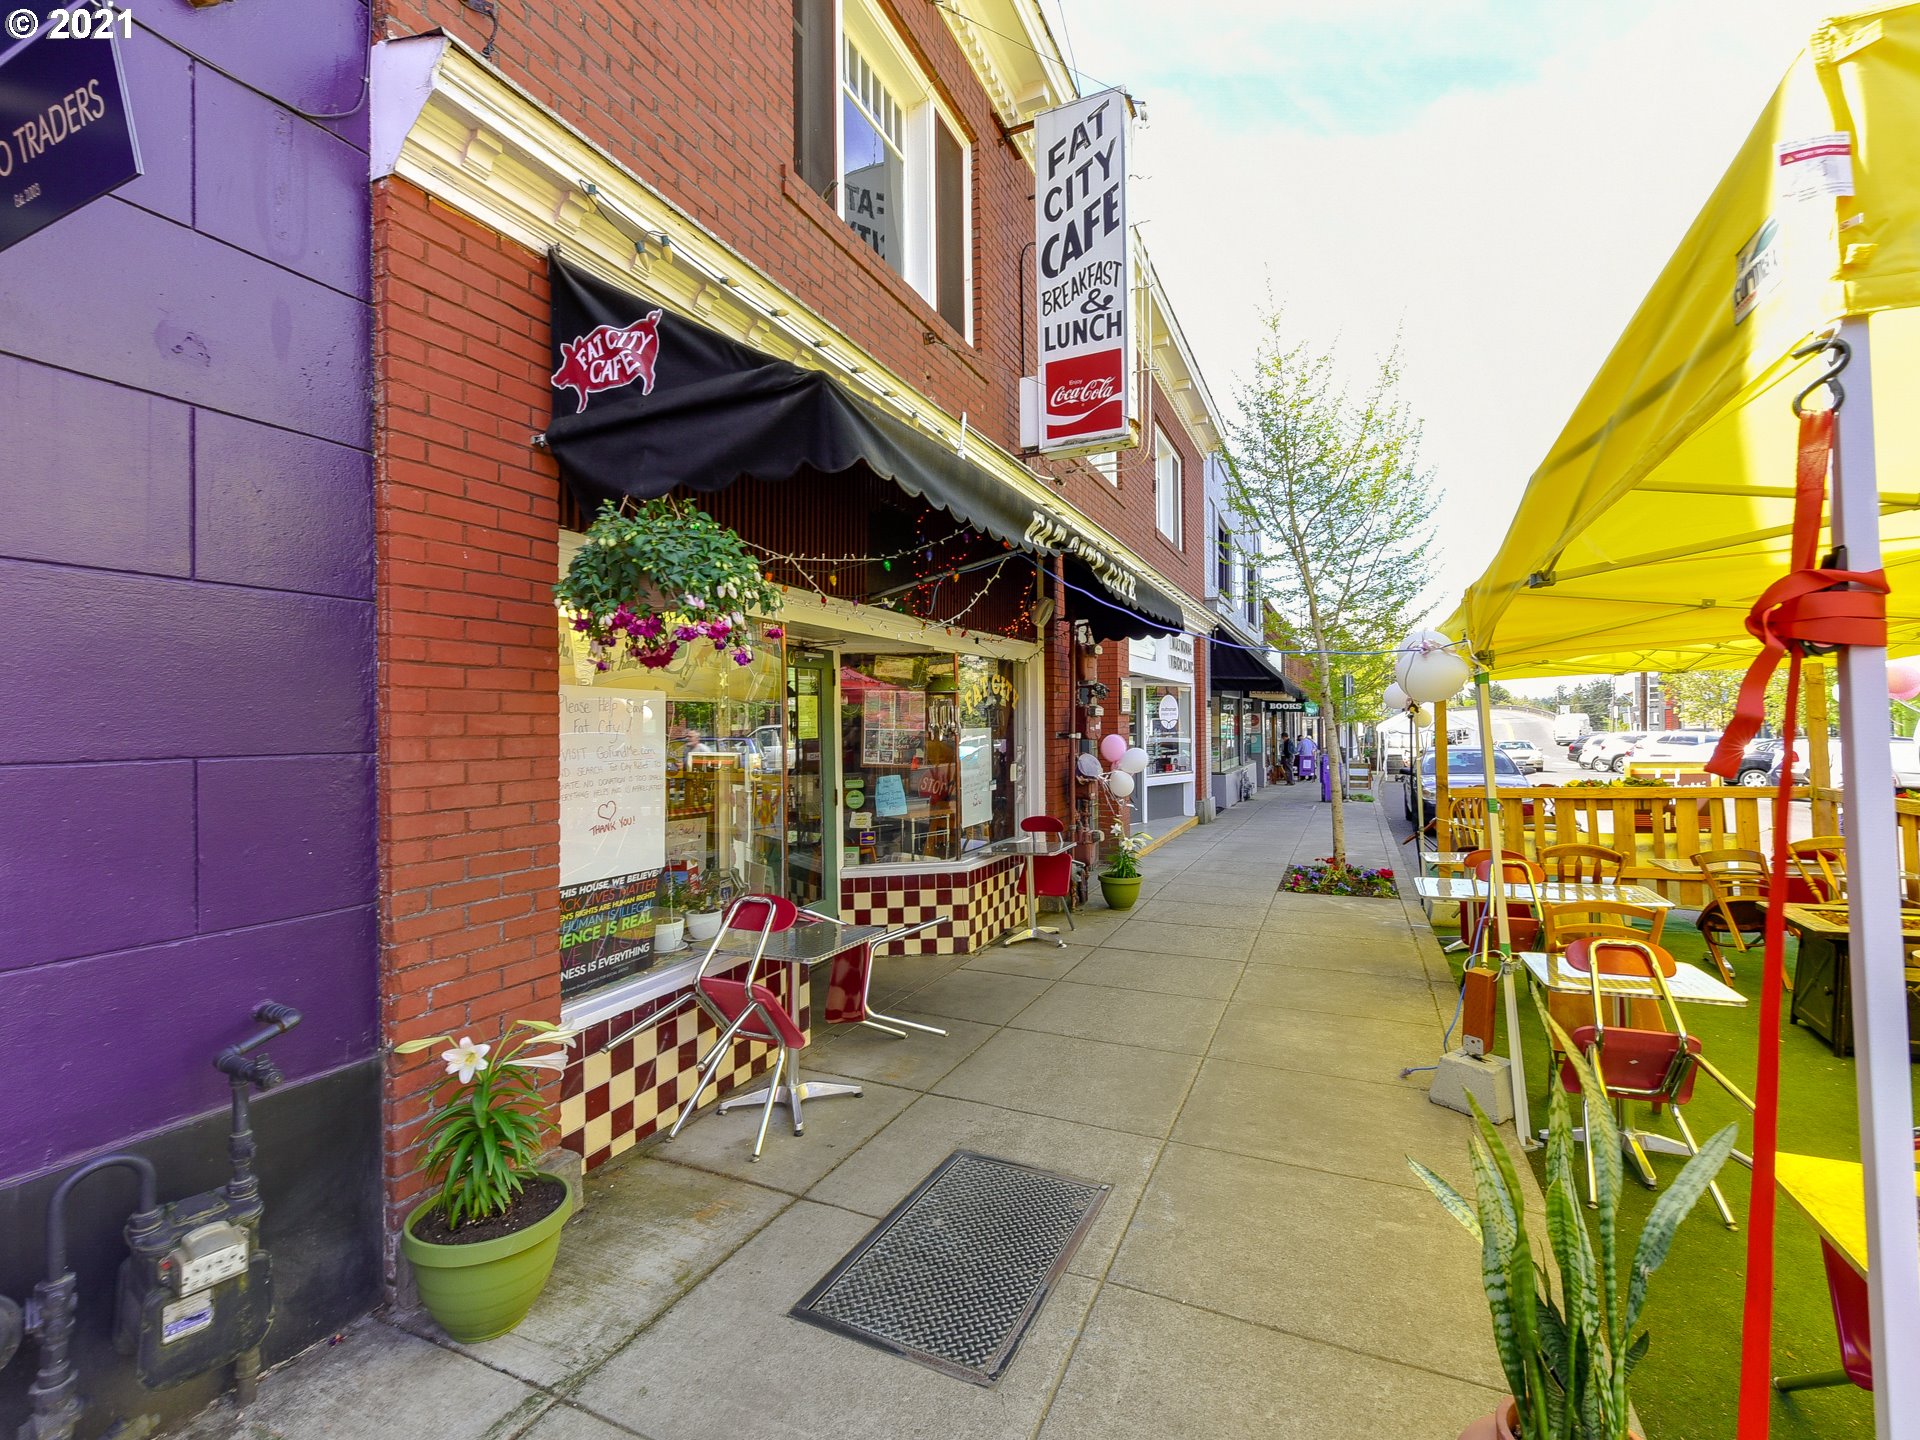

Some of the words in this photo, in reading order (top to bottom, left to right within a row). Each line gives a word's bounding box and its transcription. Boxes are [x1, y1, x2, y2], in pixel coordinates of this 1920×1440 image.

[13, 78, 105, 164] TRADERS
[1048, 99, 1110, 182] FAT
[1044, 136, 1117, 223] CITY
[1041, 182, 1120, 279] CAFE
[1042, 260, 1123, 317] BREAKFAST
[1080, 288, 1114, 314] &
[1044, 310, 1122, 352] LUNCH
[576, 334, 604, 370] FAT
[605, 330, 653, 354] CITY
[590, 350, 640, 383] CAFE
[1050, 376, 1116, 407] Coca-Cola
[1024, 510, 1067, 549] FAT
[1102, 562, 1137, 601] CAFE
[559, 694, 592, 714] Please
[598, 696, 617, 717] Help
[626, 698, 648, 714] Sav
[964, 676, 991, 716] FAT
[991, 673, 1020, 710] CITY
[1269, 702, 1303, 711] BOOKS
[573, 718, 590, 734] Fat
[561, 747, 587, 762] VISIT
[589, 821, 617, 836] THANK
[619, 815, 636, 828] YOU!
[560, 888, 577, 899] THIS
[612, 876, 625, 888] WE
[586, 888, 615, 906] LIVES
[619, 878, 658, 896] MATTER
[562, 914, 604, 935] HUMAN
[617, 900, 654, 918] ILLEGAL
[575, 905, 598, 919] RIGHTS
[599, 901, 612, 912] ARE
[612, 894, 636, 908] HUMAN
[636, 890, 657, 902] RIGHTS
[605, 920, 618, 936] IS
[621, 911, 653, 931] REAL
[560, 964, 587, 982] NESS
[587, 960, 598, 972] IS
[598, 942, 651, 969] EVERYTHING
